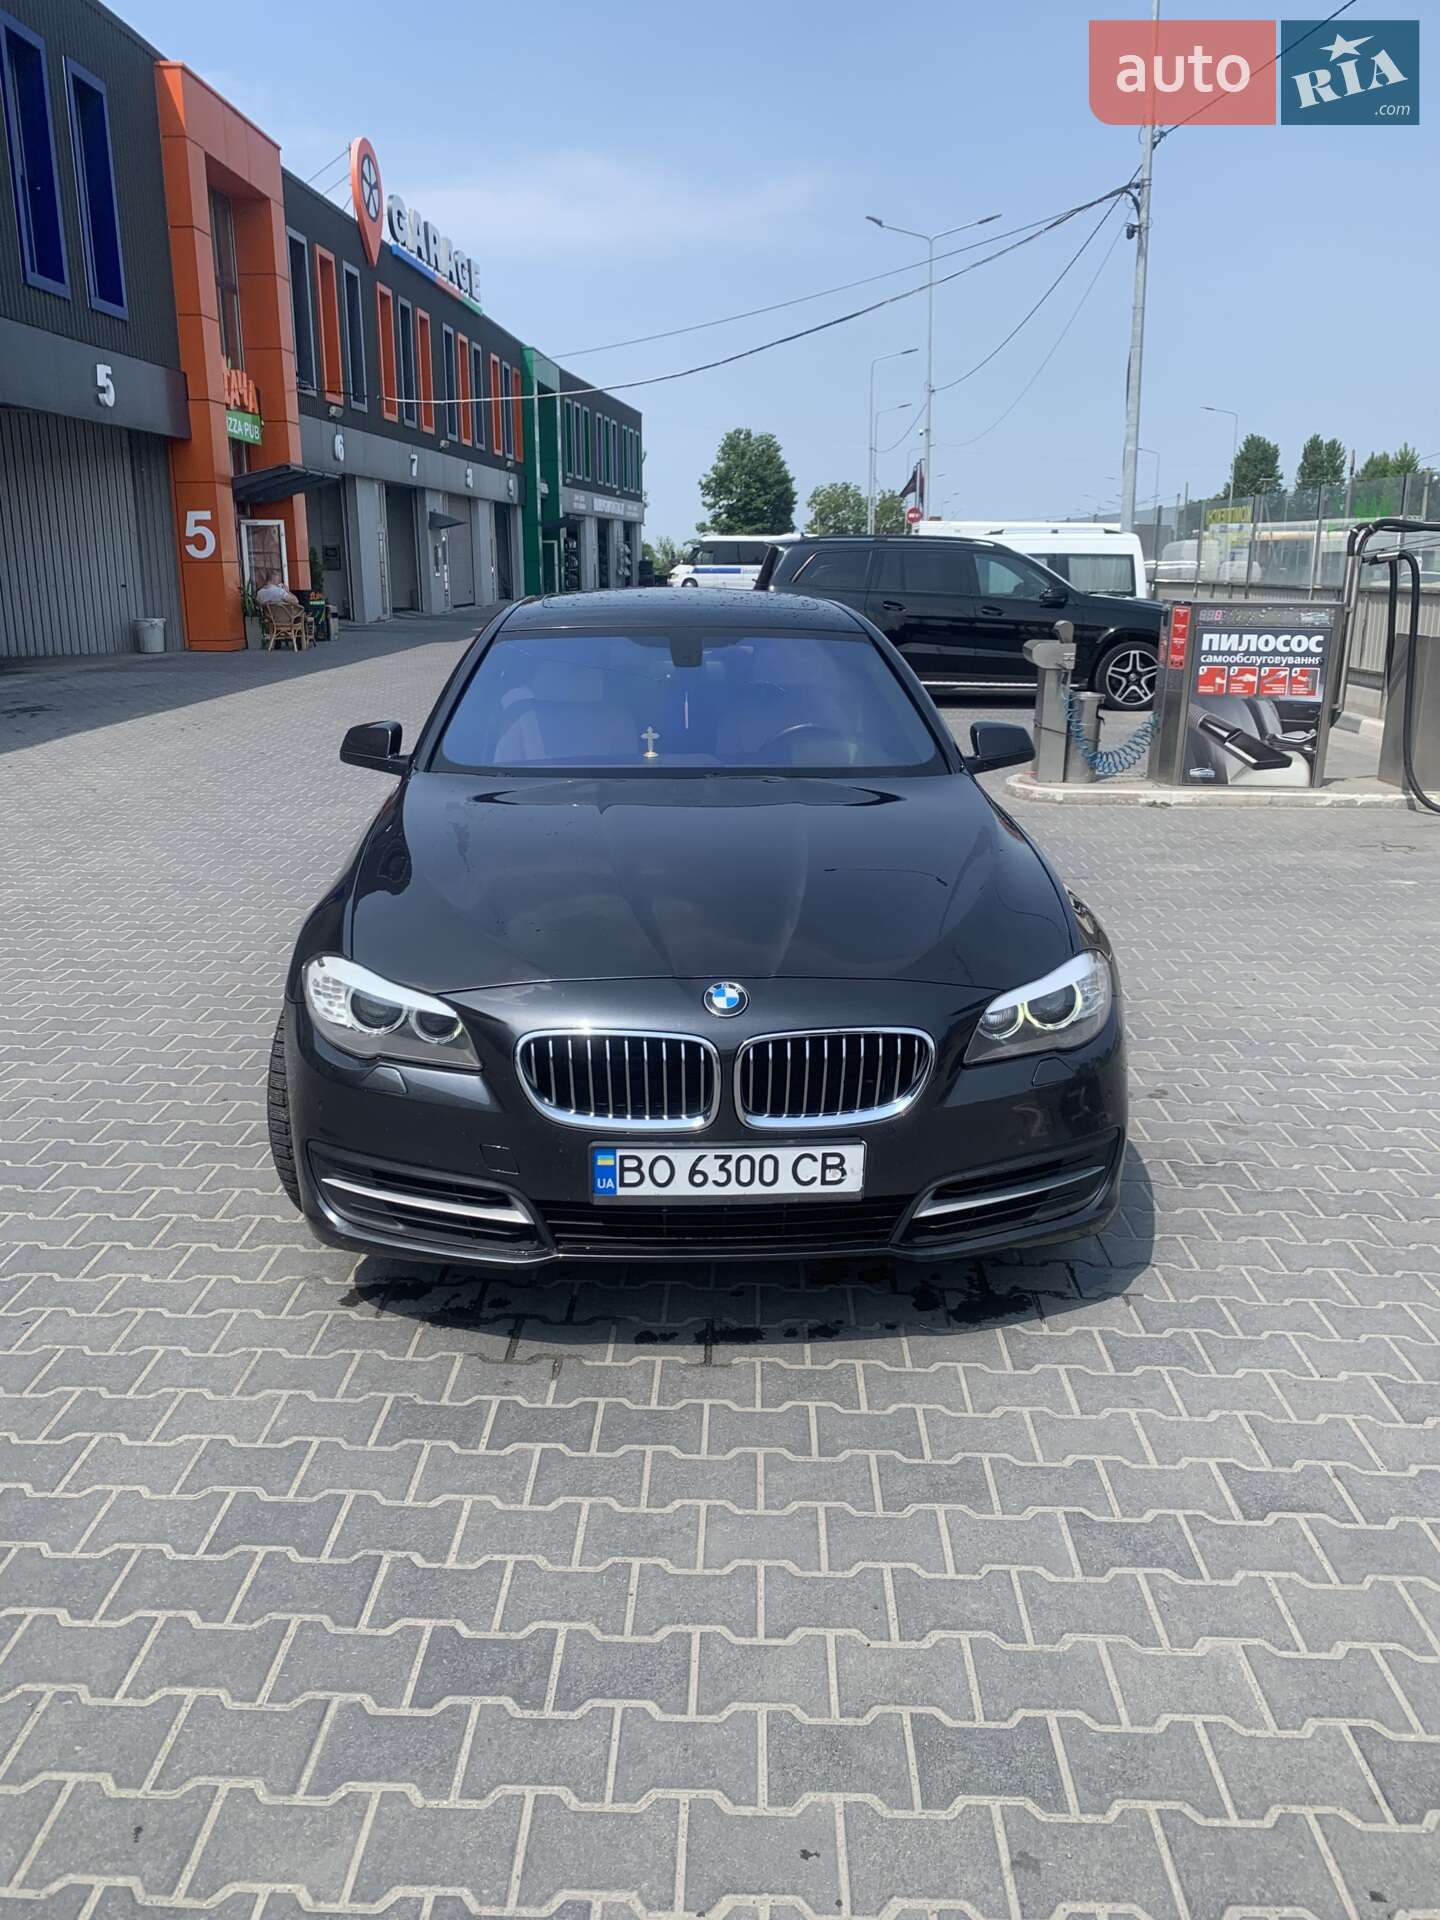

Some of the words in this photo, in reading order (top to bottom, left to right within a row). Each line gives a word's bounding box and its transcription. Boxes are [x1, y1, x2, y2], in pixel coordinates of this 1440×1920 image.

[387, 194, 481, 303] GARAGE
[95, 363, 116, 408] 5
[243, 421, 260, 441] PUB
[333, 433, 345, 463] 6
[410, 453, 419, 478] 7
[185, 510, 216, 559] 5
[1201, 633, 1325, 653] ПИЛОСОС
[597, 1178, 615, 1189] UA
[618, 1154, 676, 1188] BO
[687, 1153, 779, 1188] 6300
[791, 1151, 848, 1187] CB
